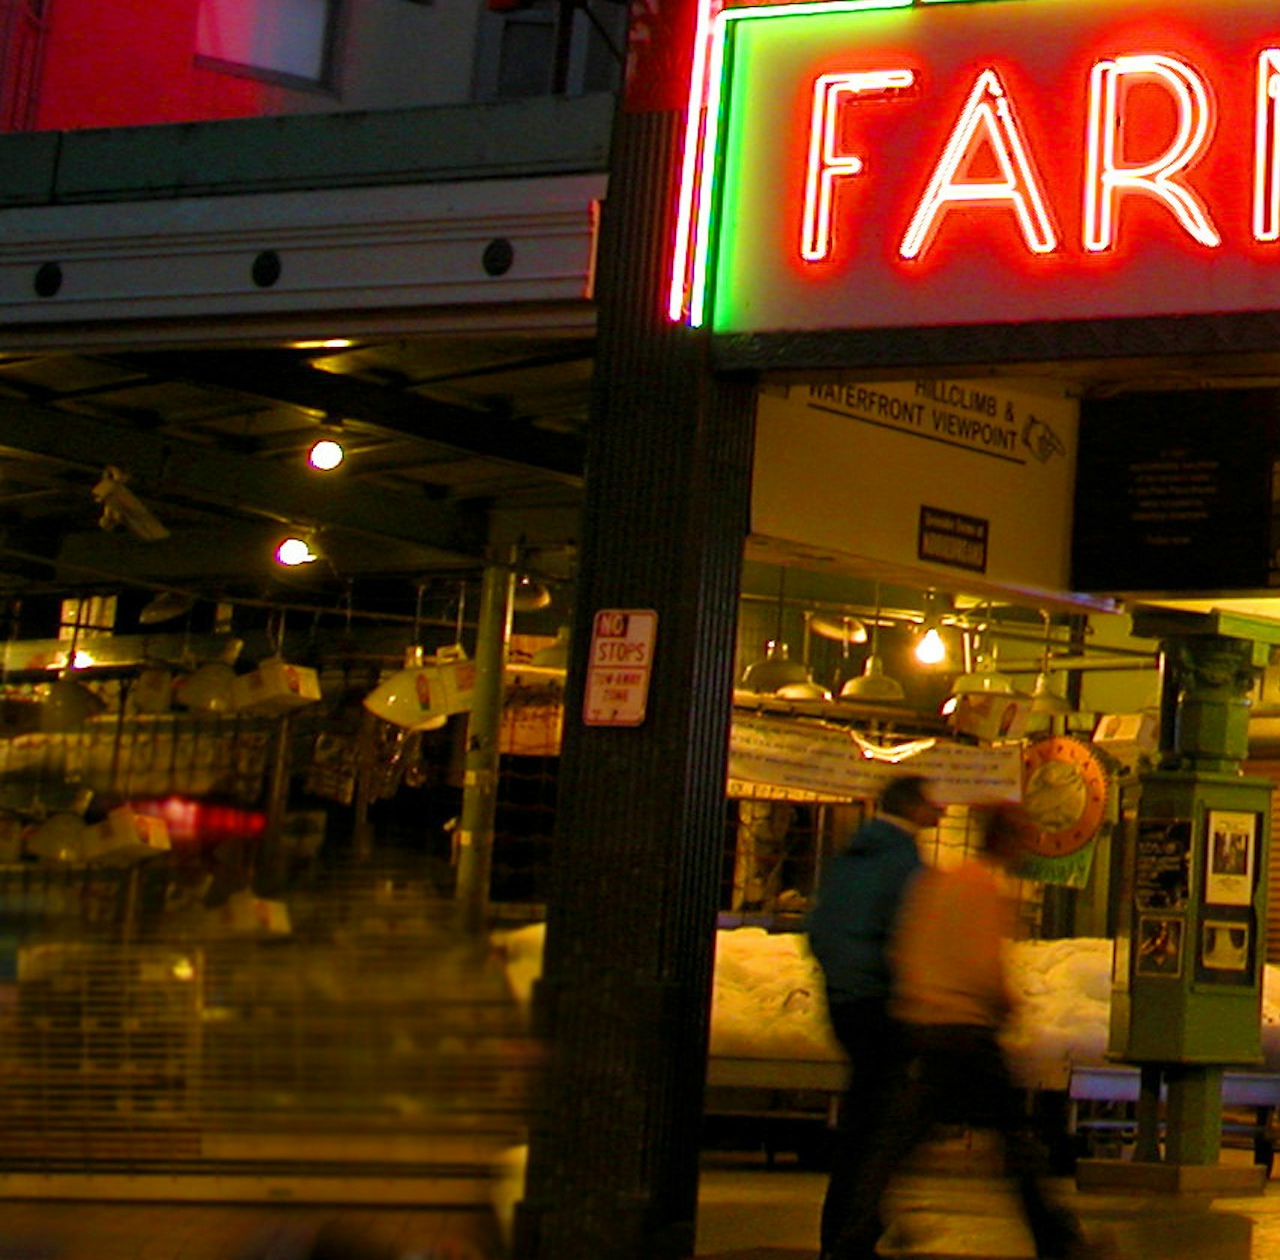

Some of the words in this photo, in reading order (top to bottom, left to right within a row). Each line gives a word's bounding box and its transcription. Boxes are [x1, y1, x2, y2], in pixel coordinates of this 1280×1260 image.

[915, 380, 997, 416] HILLCLIMB
[1004, 401, 1014, 422] &
[808, 383, 924, 425] WATERFRONT
[932, 409, 1018, 451] VIEWPOINT
[600, 615, 624, 634] NO
[598, 643, 645, 662] STOPS
